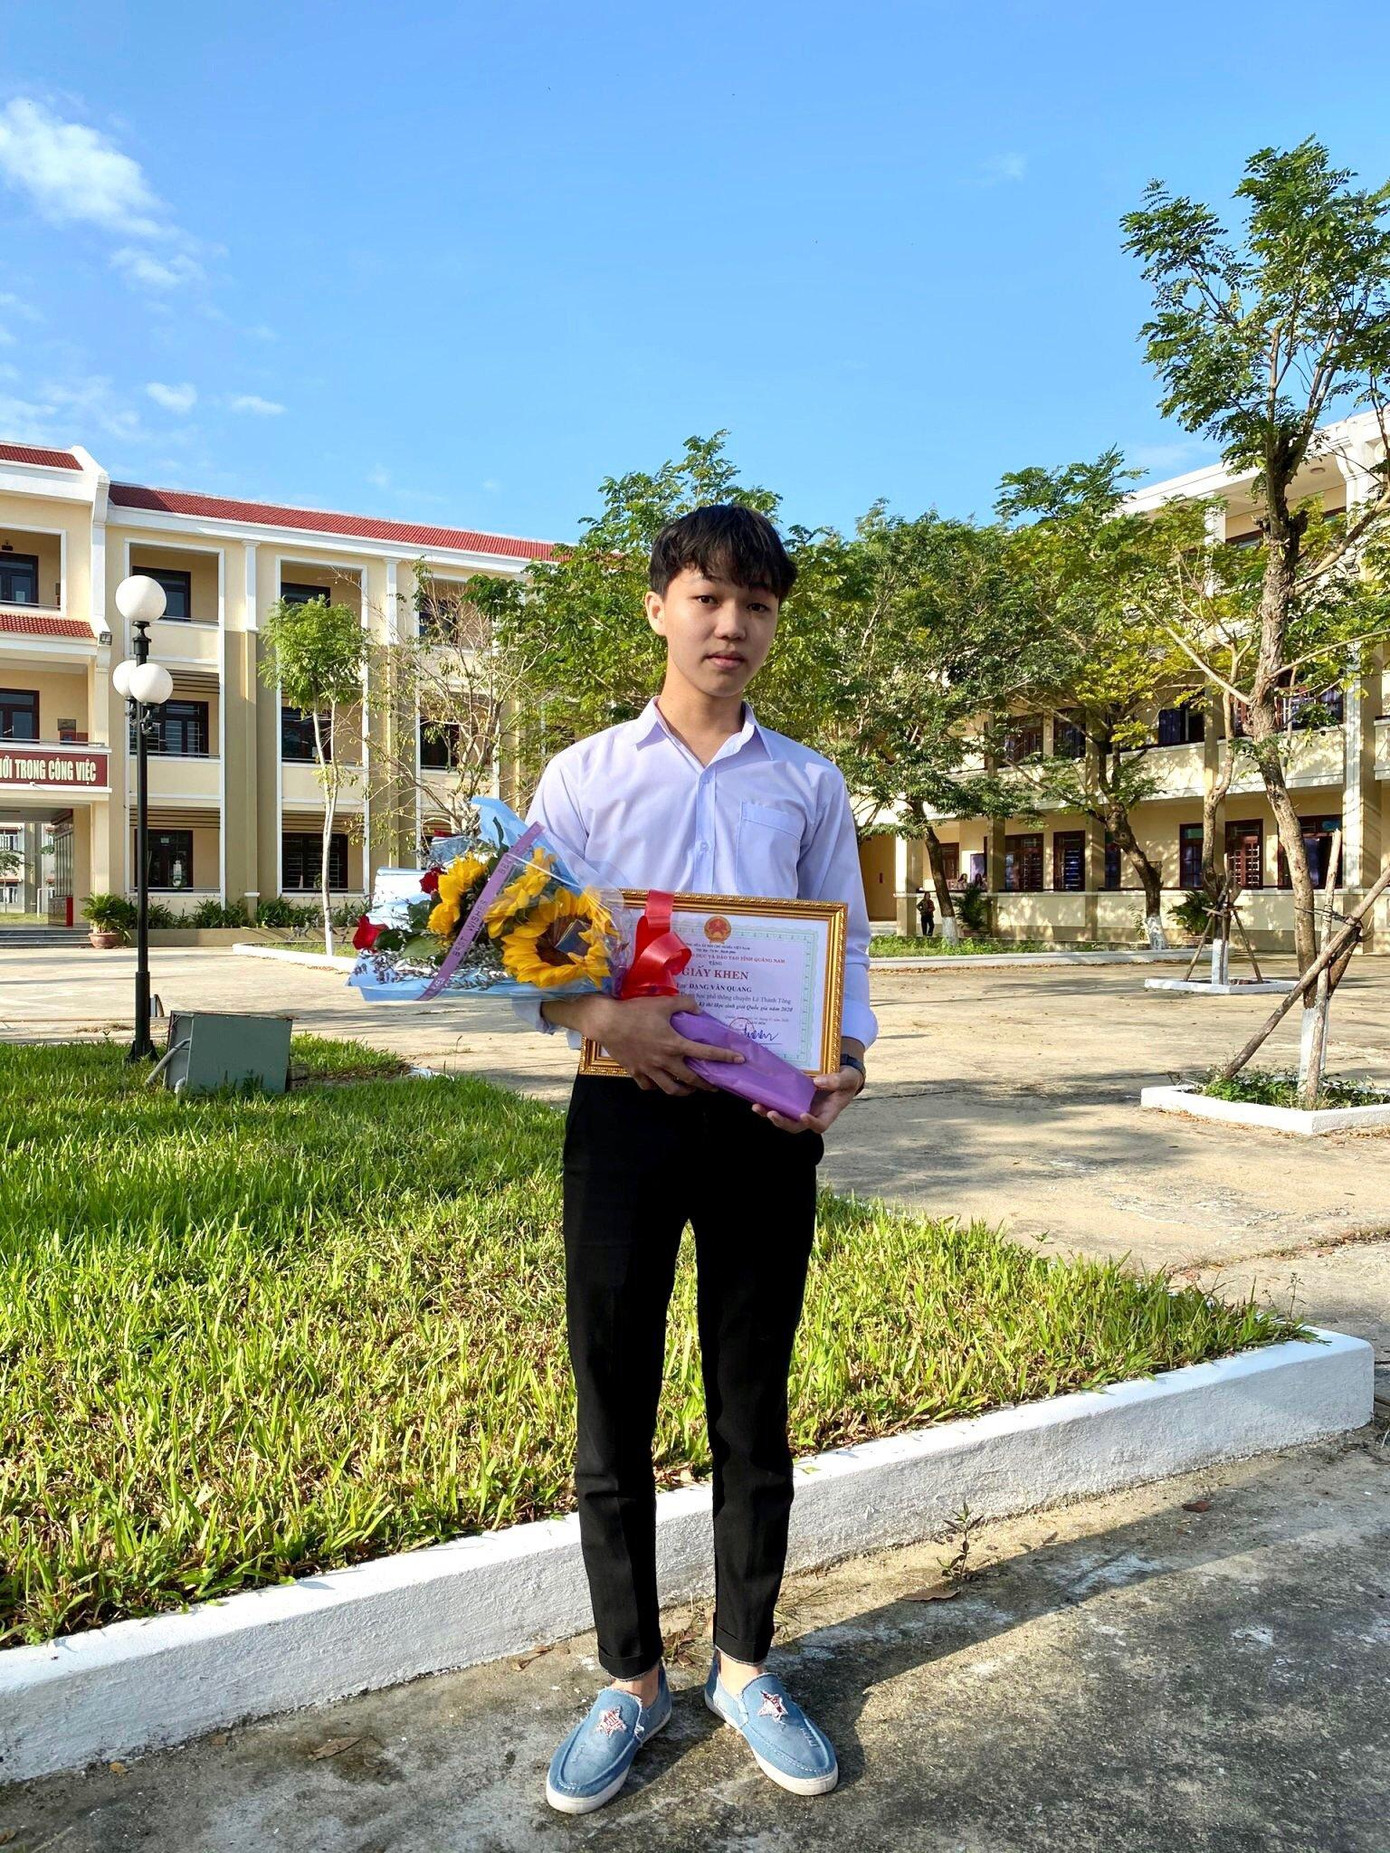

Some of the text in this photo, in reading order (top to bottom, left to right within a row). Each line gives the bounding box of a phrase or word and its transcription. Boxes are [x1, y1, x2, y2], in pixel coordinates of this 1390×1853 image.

[15, 759, 46, 780] TRONG
[48, 757, 74, 780] CÔNG
[75, 758, 96, 785] VIỆC
[452, 936, 469, 957] BEST
[467, 899, 487, 931] WISHES
[682, 964, 749, 980] GIẤY KHEN
[710, 983, 725, 991] VĂN
[726, 985, 752, 993] QUANG
